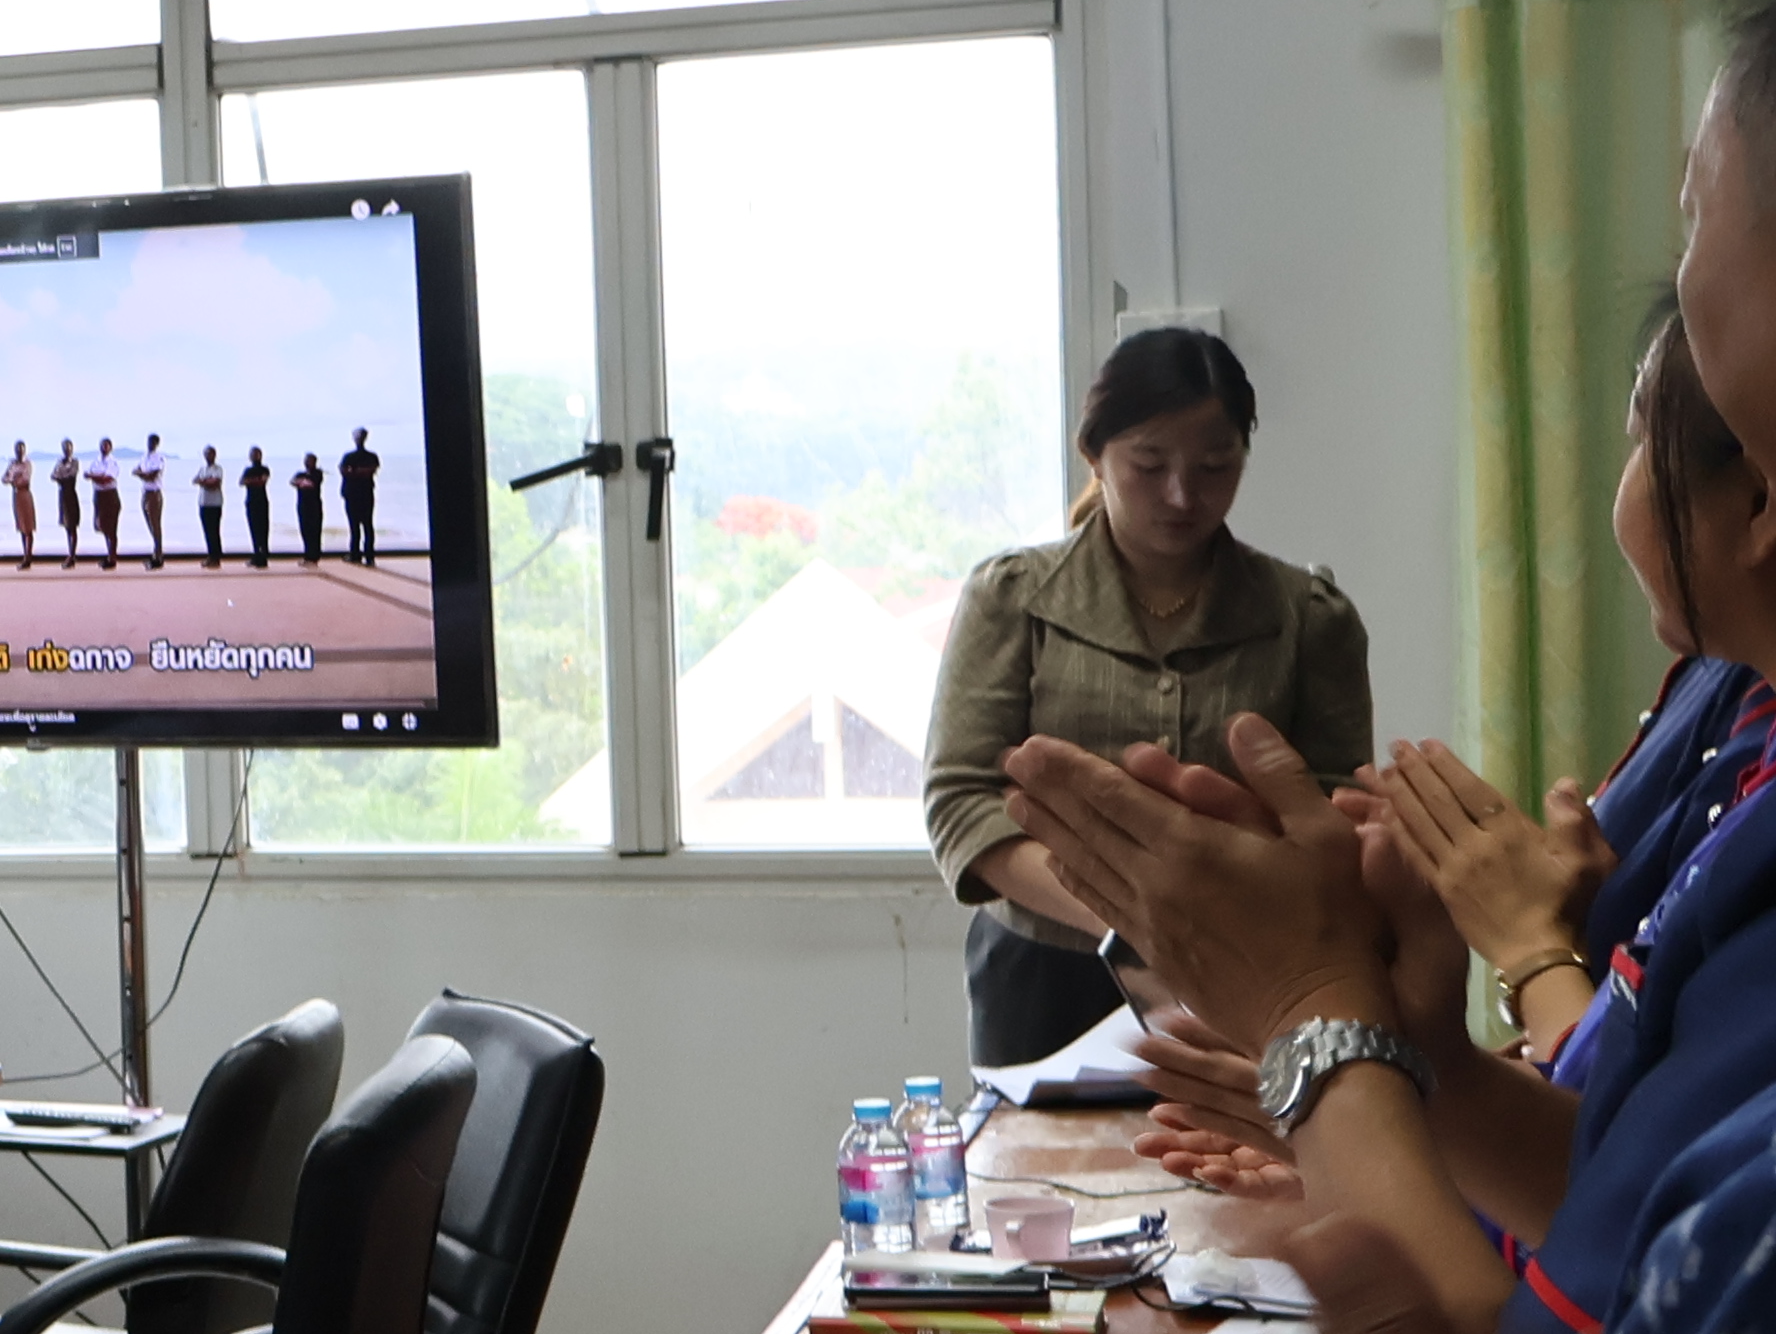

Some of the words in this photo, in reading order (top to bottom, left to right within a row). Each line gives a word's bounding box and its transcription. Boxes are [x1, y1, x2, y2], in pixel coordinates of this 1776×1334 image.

[25, 641, 135, 674] เก่งฉกาจ
[148, 638, 316, 680] ยืนหยัดทุกคน
